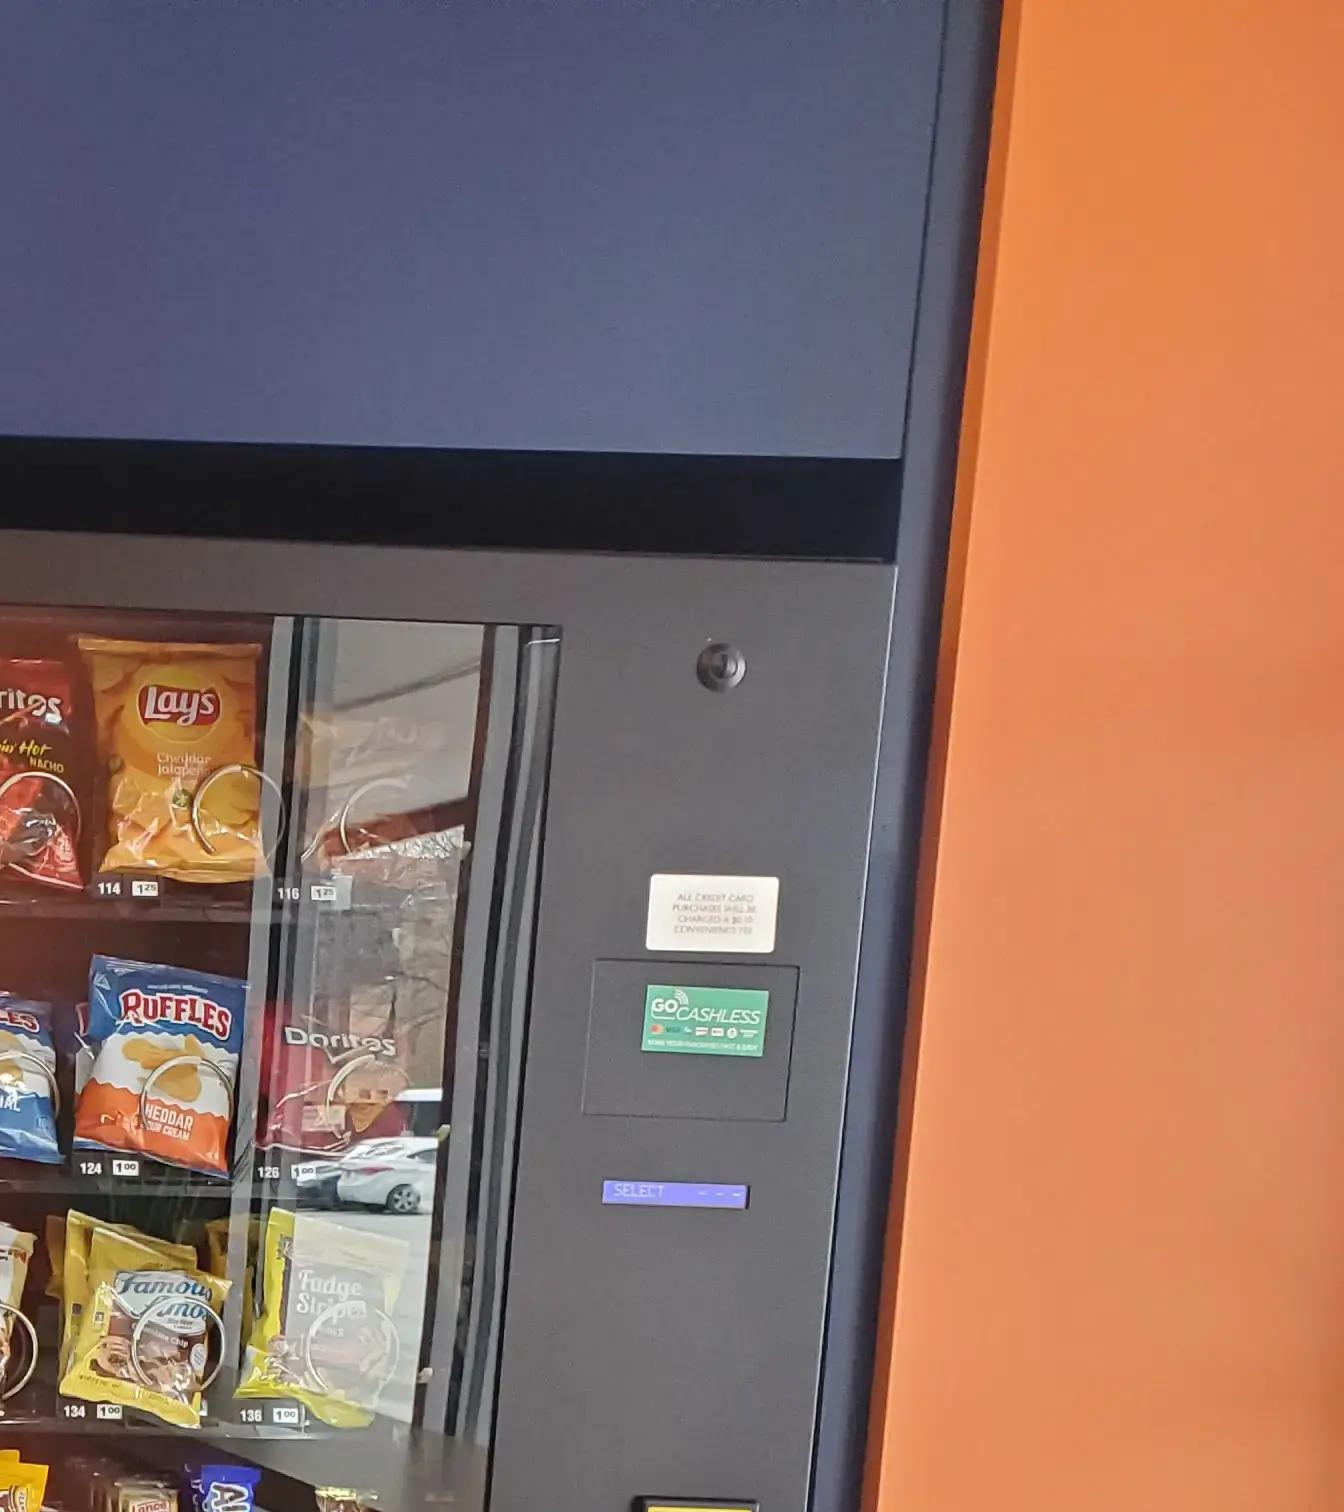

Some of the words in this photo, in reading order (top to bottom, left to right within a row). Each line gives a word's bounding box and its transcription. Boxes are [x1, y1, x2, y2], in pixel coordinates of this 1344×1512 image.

[144, 685, 216, 726] Lay's
[18, 740, 52, 755] Hot
[29, 756, 64, 774] NACHO
[97, 882, 121, 895] 114
[277, 886, 300, 900] 116
[119, 989, 231, 1039] RUFFLES
[651, 998, 678, 1013] GO
[676, 1006, 761, 1025] CASHLESS
[284, 1025, 397, 1056] Doritos
[145, 1103, 193, 1130] HEDDAR
[162, 1123, 190, 1141] CREAM
[79, 1163, 102, 1175] 124
[257, 1166, 280, 1179] 126
[613, 1183, 665, 1197] SELECT
[297, 1269, 362, 1296] Fudge
[63, 1404, 86, 1417] 134
[240, 1409, 262, 1422] 136
